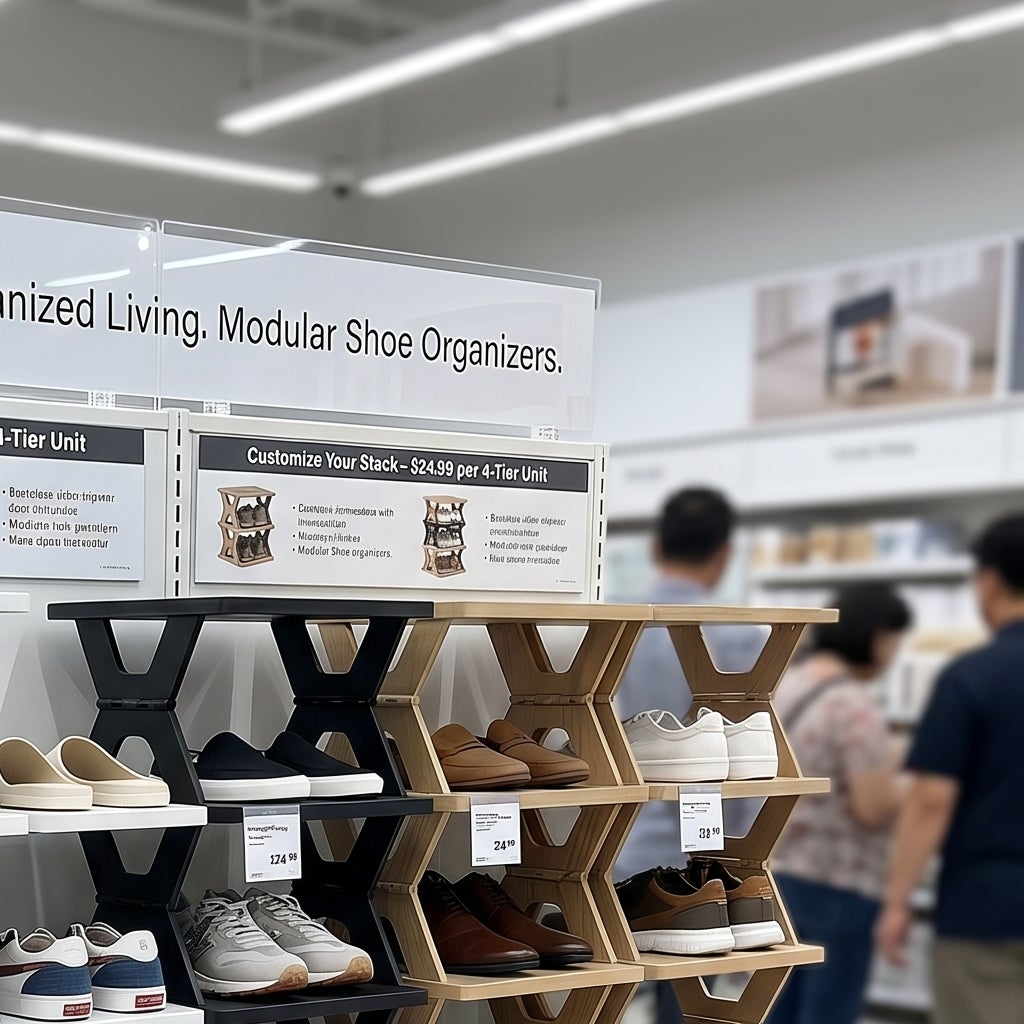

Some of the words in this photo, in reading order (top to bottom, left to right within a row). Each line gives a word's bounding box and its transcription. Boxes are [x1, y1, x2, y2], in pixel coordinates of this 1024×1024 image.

[108, 292, 207, 349] Living.
[219, 304, 337, 352] Modular
[345, 318, 413, 359] Shoe
[421, 326, 563, 374] Organizers.
[50, 431, 87, 453] Unit
[247, 446, 323, 468] Customize
[325, 451, 358, 470] Your
[359, 453, 399, 473] Stack
[410, 456, 454, 477] $24.99
[456, 464, 479, 481] per
[481, 463, 520, 481] 4-Tier
[521, 465, 548, 483] Unit
[331, 546, 350, 557] Shoe
